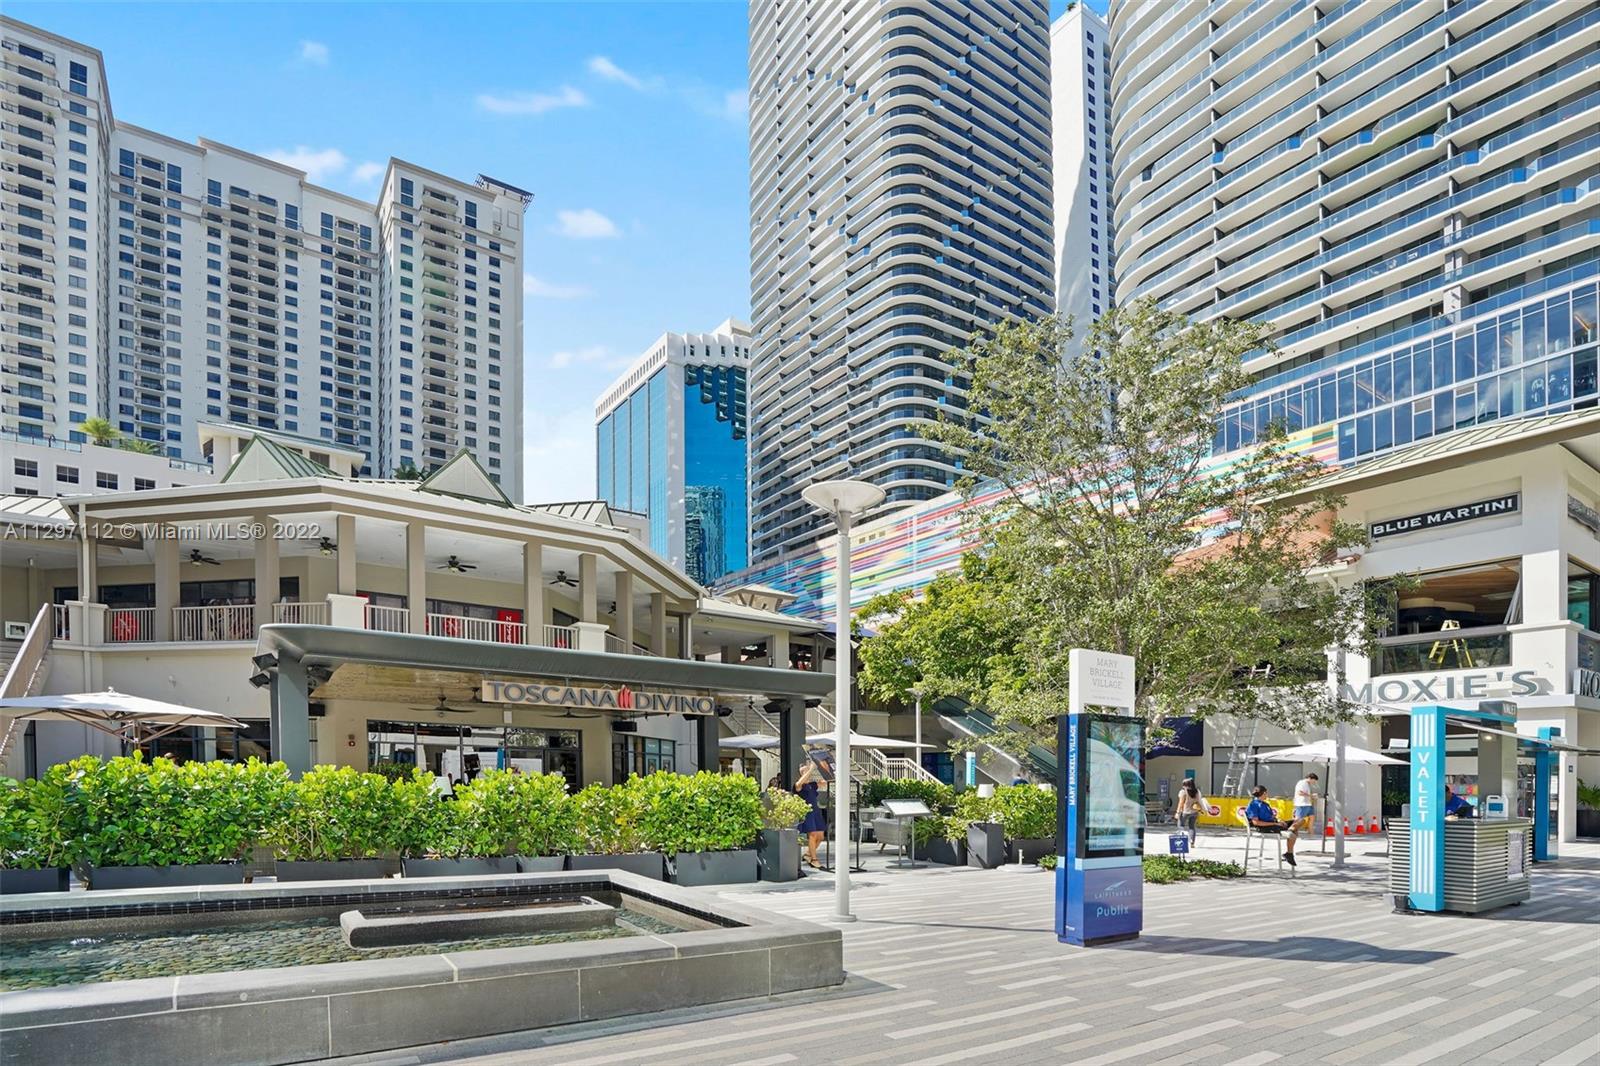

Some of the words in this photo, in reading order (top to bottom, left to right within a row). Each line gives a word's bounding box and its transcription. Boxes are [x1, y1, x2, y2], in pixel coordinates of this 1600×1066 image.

[1373, 517, 1422, 535] BLUE
[1427, 498, 1513, 524] MARTINI
[1089, 667, 1125, 680] BRICKELL
[1096, 657, 1118, 668] MARY
[1092, 678, 1123, 689] VILLAGE
[1340, 670, 1538, 703] MOXIE'S
[487, 681, 618, 709] TOSCANA
[634, 692, 714, 713] DIVINO
[1417, 752, 1430, 823] VALET
[1096, 904, 1129, 918] Publix
